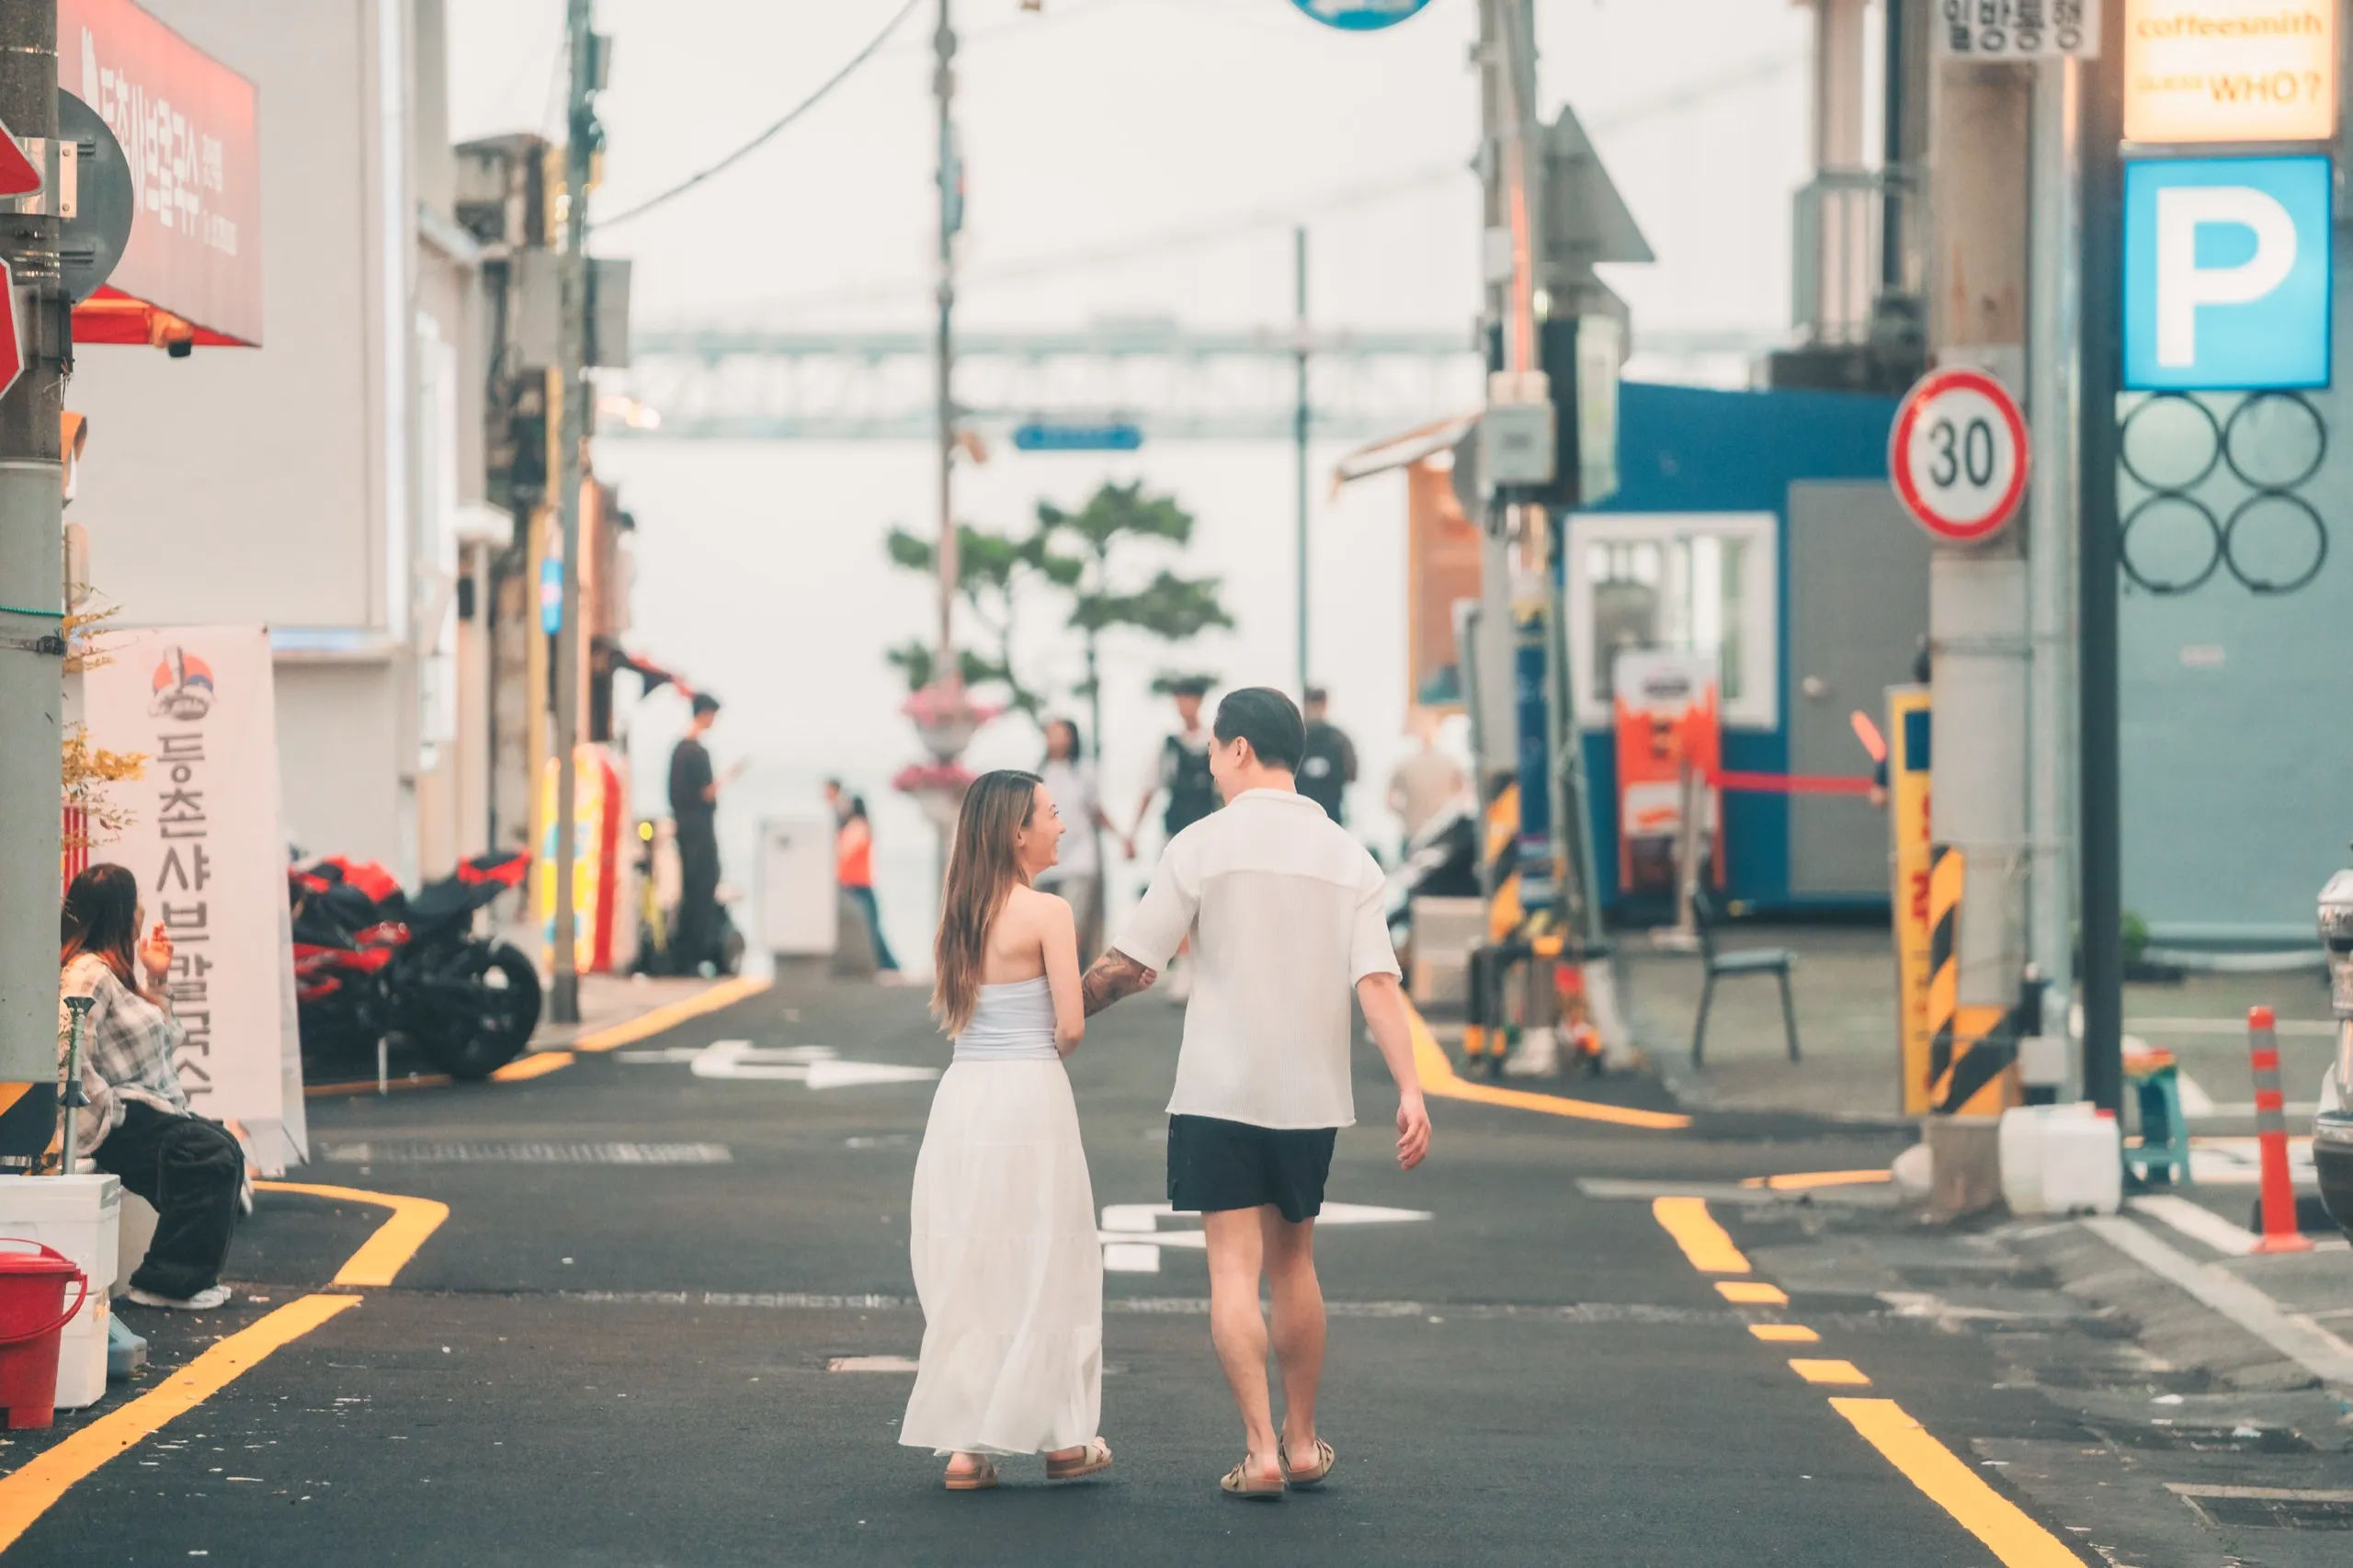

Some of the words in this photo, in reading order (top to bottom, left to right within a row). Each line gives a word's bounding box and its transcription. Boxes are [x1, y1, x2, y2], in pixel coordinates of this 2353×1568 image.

[1944, 0, 2083, 52] 일방통행
[2137, 11, 2323, 37] coffeesmith
[2210, 70, 2322, 104] WHO?
[2156, 186, 2298, 369] P
[1928, 415, 1995, 488] 30
